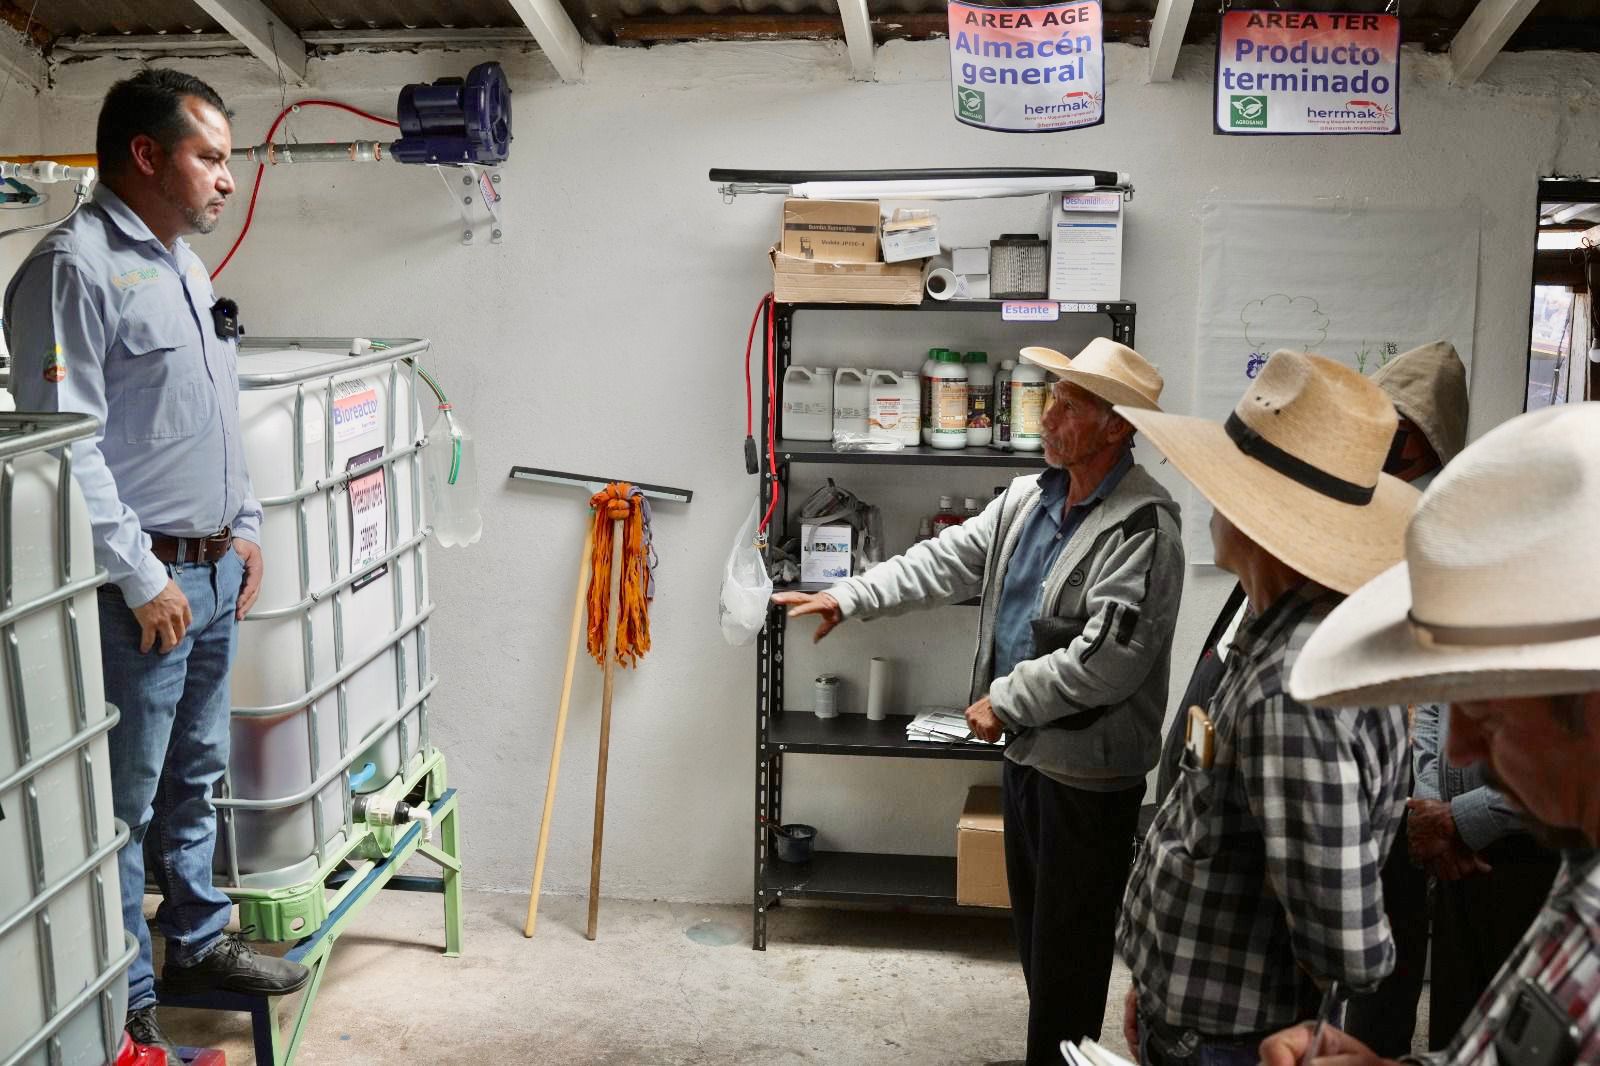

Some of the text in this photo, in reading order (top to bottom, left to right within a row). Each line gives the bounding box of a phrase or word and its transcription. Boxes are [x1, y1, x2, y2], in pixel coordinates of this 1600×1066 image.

[965, 7, 1089, 29] AREA AGE
[1246, 13, 1380, 31] AREA TER
[955, 31, 1092, 59] Almacén
[1235, 39, 1380, 66] Producto
[962, 57, 1085, 85] general
[1223, 68, 1390, 94] terminado
[1024, 99, 1088, 115] herrmak
[1307, 107, 1377, 119] herrmak
[1005, 305, 1049, 314] Estante
